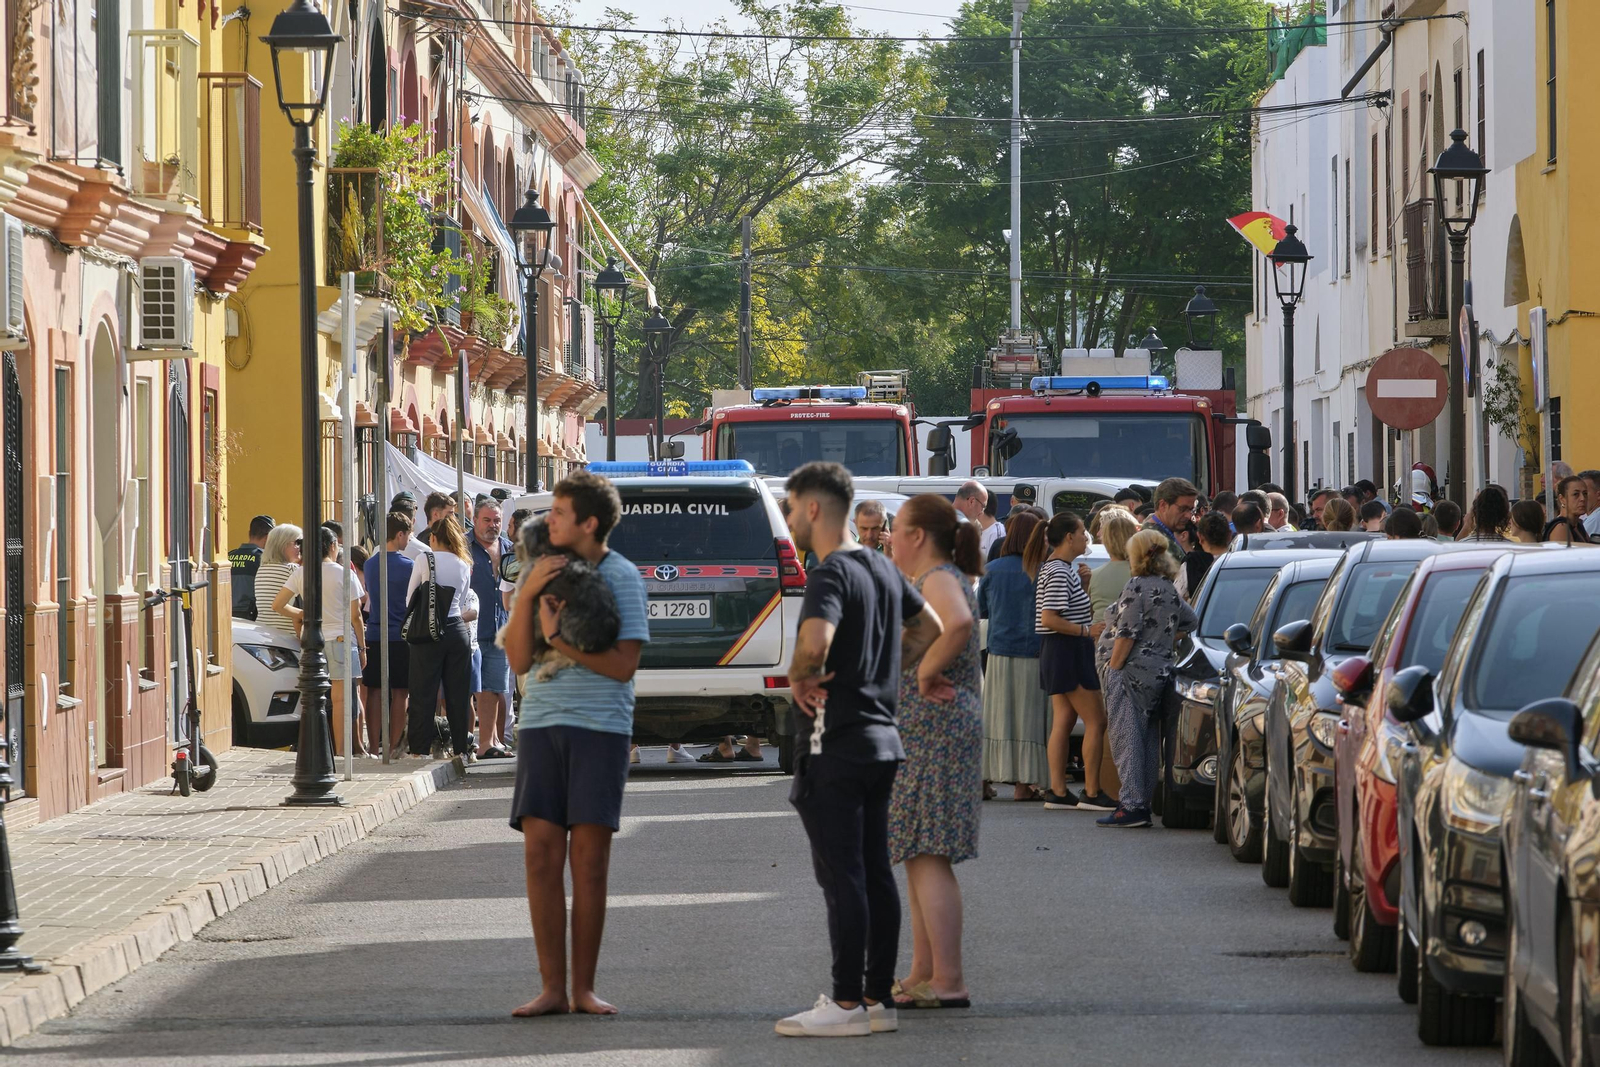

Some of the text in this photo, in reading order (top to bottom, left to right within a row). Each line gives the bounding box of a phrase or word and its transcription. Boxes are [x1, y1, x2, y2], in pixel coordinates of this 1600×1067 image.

[619, 503, 729, 516] UARDIA CIVIL
[228, 554, 256, 563] UARDIA
[656, 582, 716, 592] CRUISER
